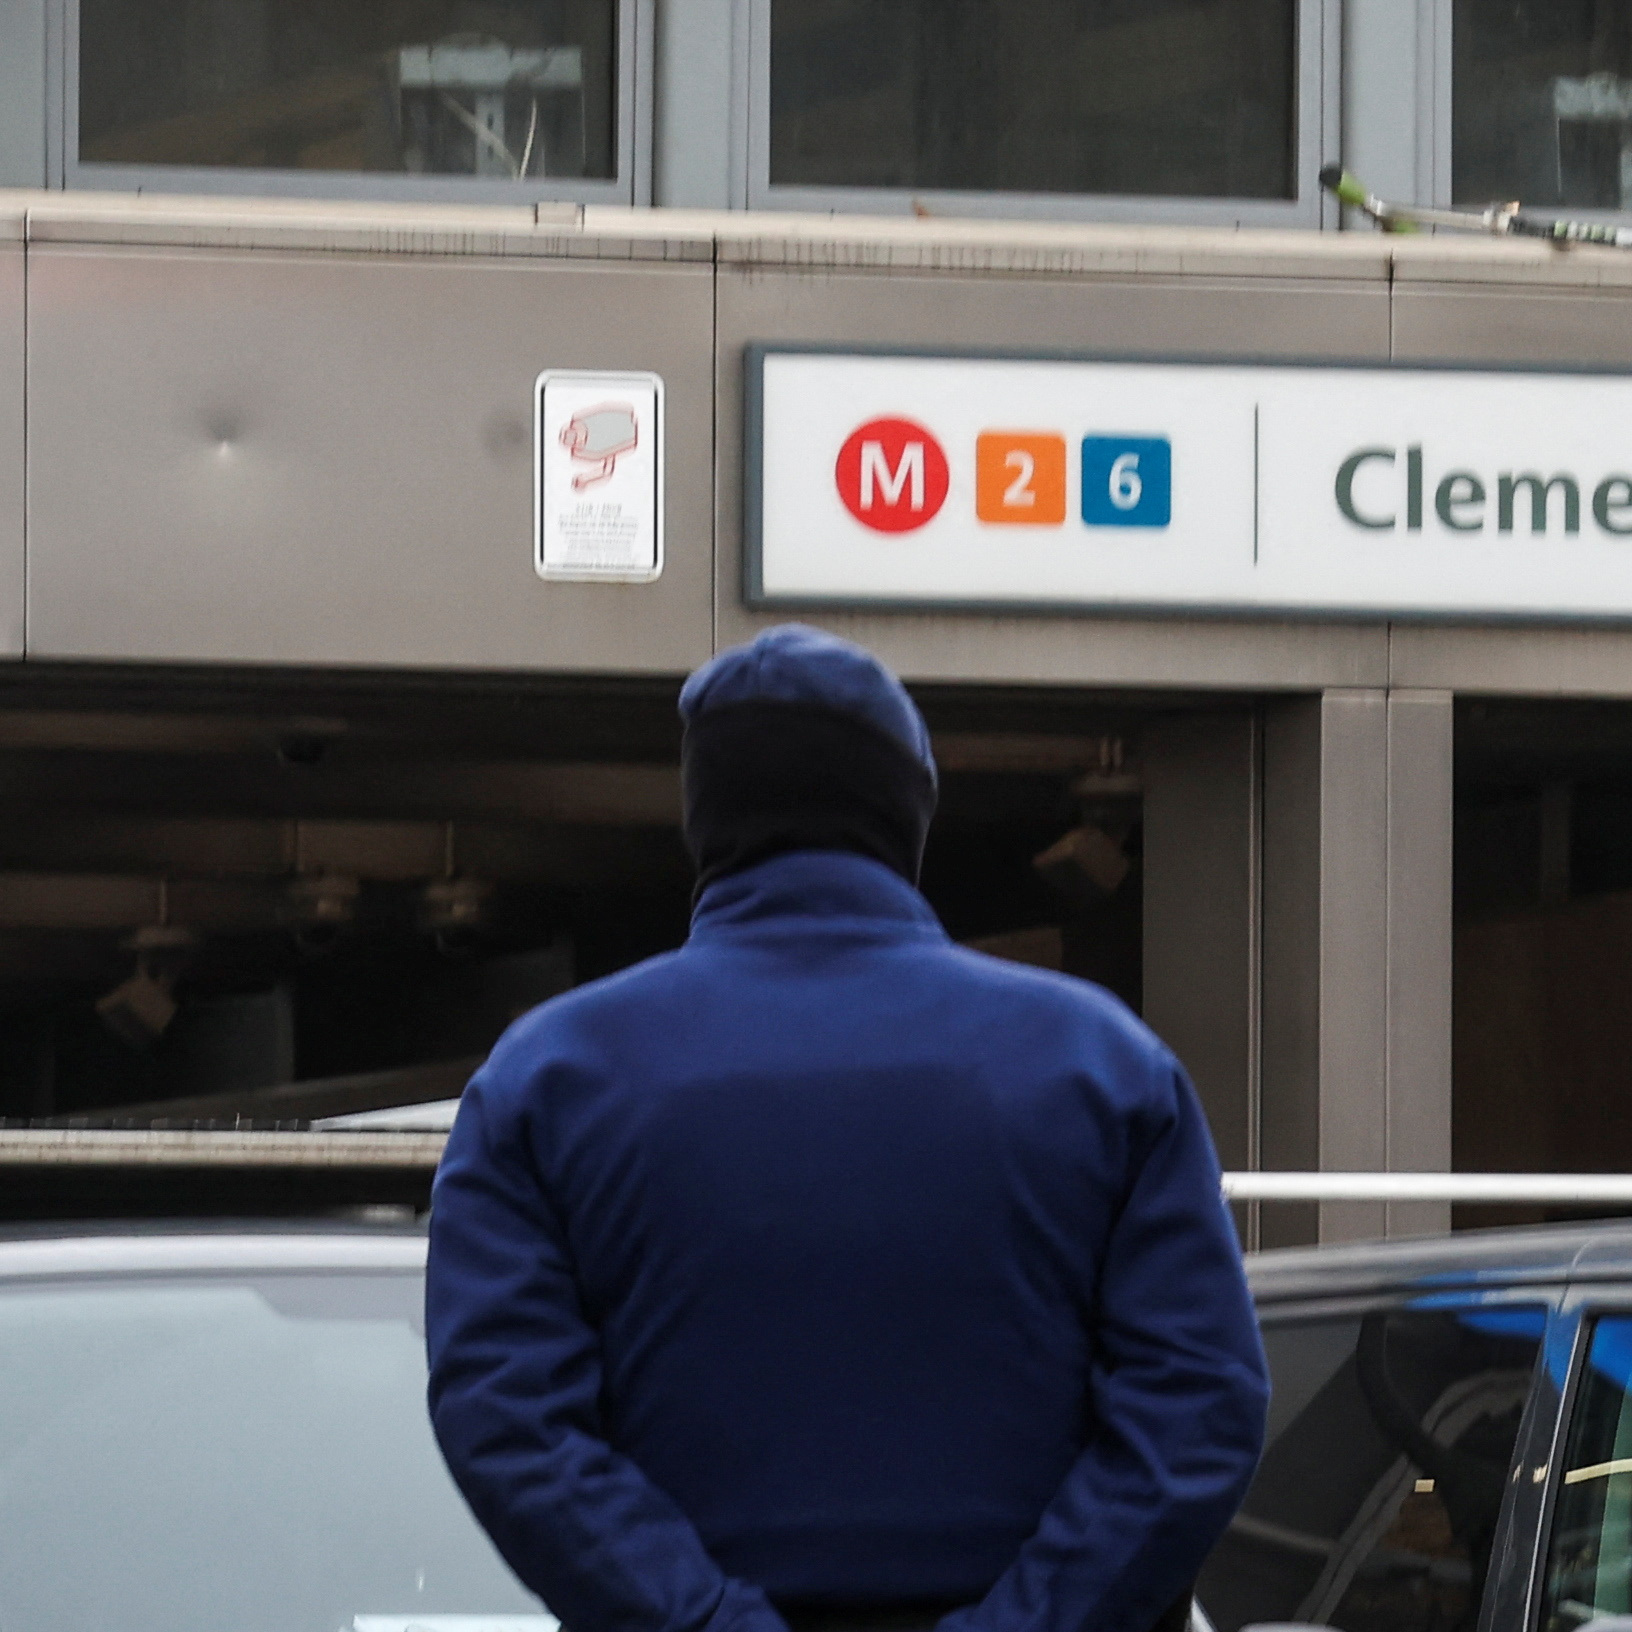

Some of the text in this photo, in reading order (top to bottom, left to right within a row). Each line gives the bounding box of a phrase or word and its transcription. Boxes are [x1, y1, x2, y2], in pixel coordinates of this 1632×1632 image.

[859, 440, 925, 512] M
[1003, 450, 1036, 507] 2
[1107, 452, 1143, 511] 6
